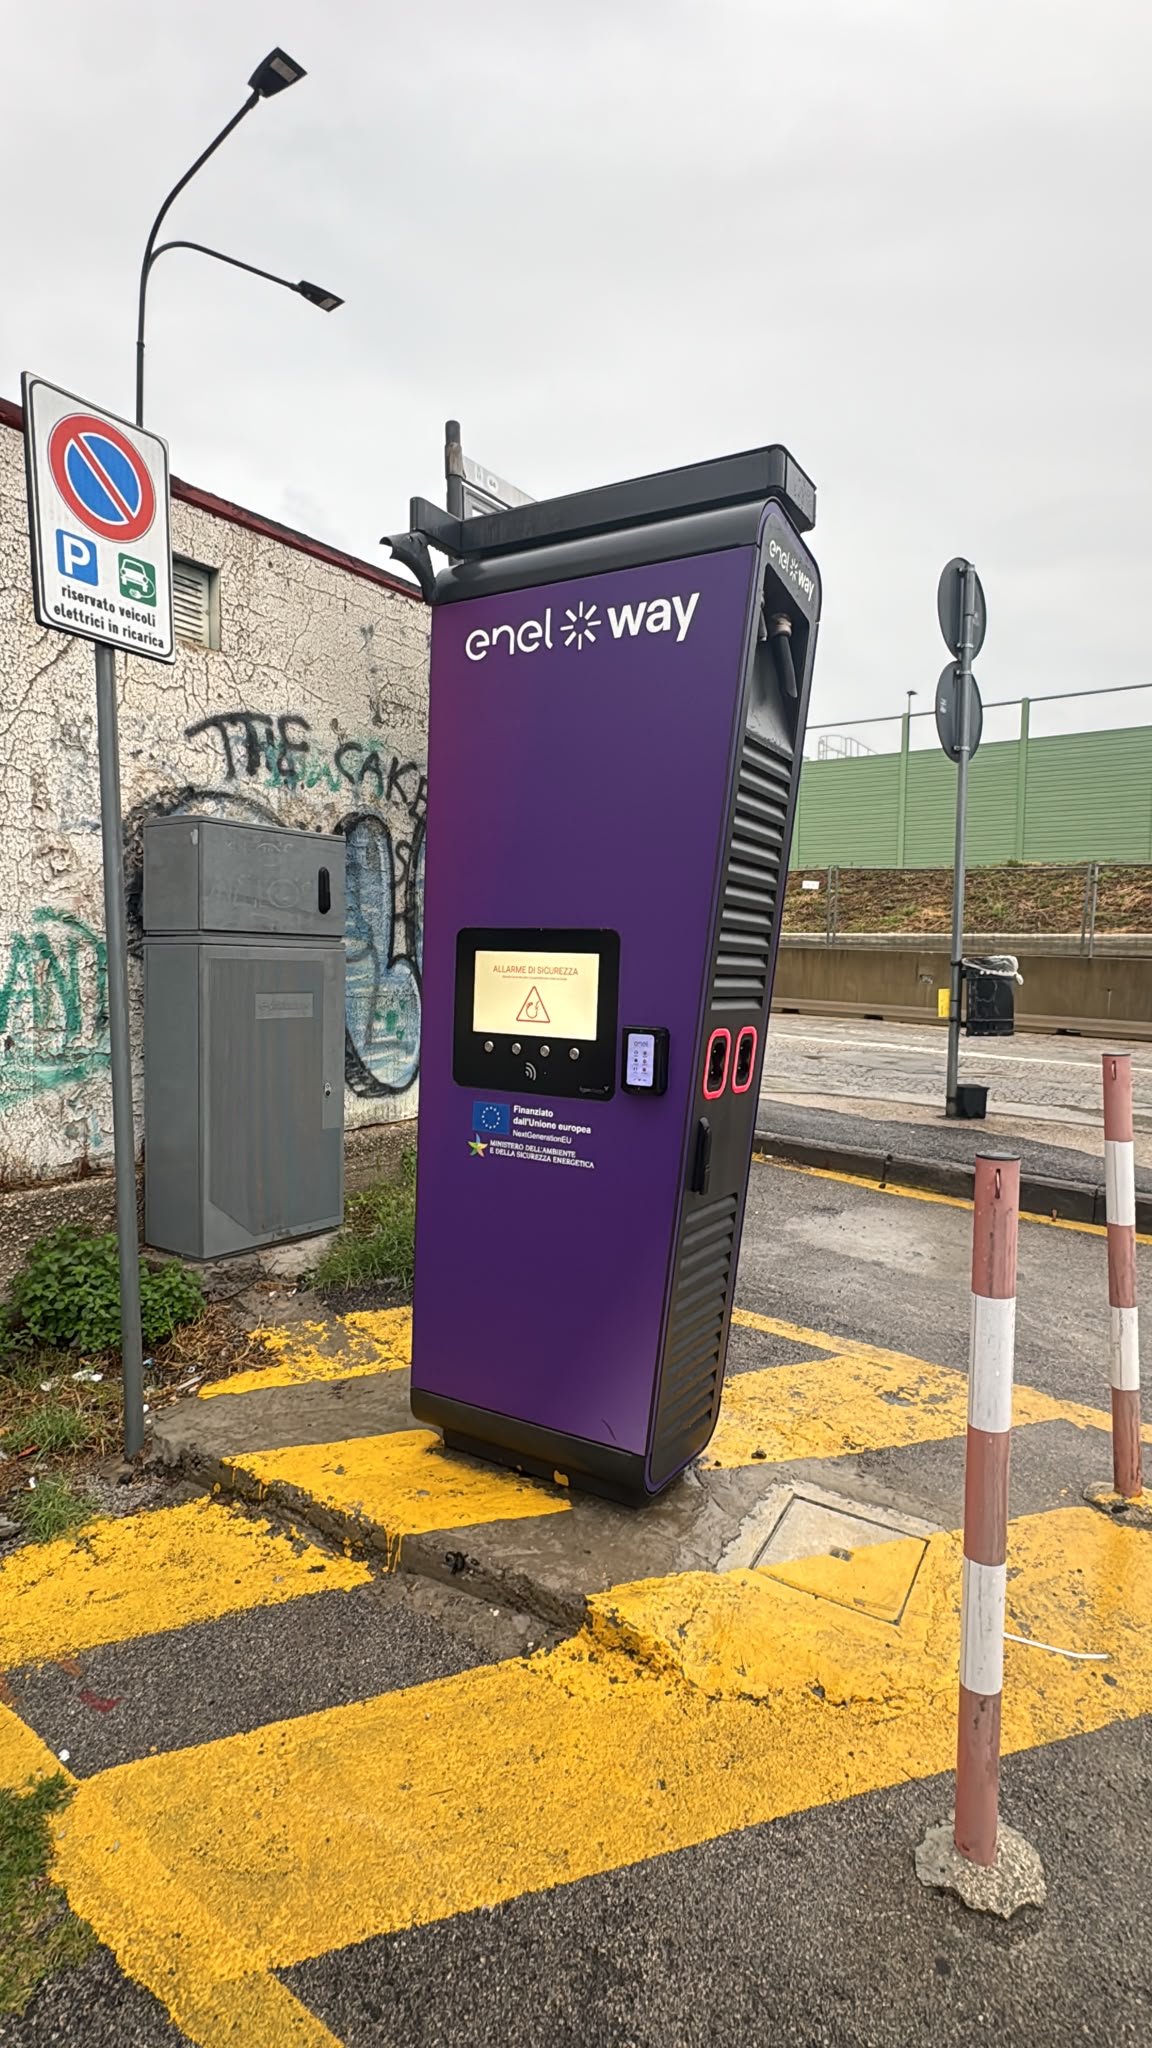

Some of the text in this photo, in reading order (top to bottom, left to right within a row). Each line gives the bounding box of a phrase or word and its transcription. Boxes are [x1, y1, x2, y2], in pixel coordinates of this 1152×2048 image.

[62, 533, 91, 576] P
[769, 539, 815, 602] enel way
[61, 585, 156, 628] riservato veicoli
[53, 603, 165, 649] elettrici in ricarica
[465, 592, 701, 661] enel way
[492, 965, 579, 976] ALLARME DI SICUREZZA
[513, 1104, 554, 1118] Finanziato
[512, 1117, 592, 1135] dall'Unione europea
[512, 1129, 572, 1144] NextGenerationEU
[489, 1139, 576, 1158] MINISTERO DELL'AMBIENTE
[495, 1148, 516, 1158] DELLA
[516, 1151, 552, 1163] SICUREZZA
[552, 1156, 595, 1169] ENERGETICA
